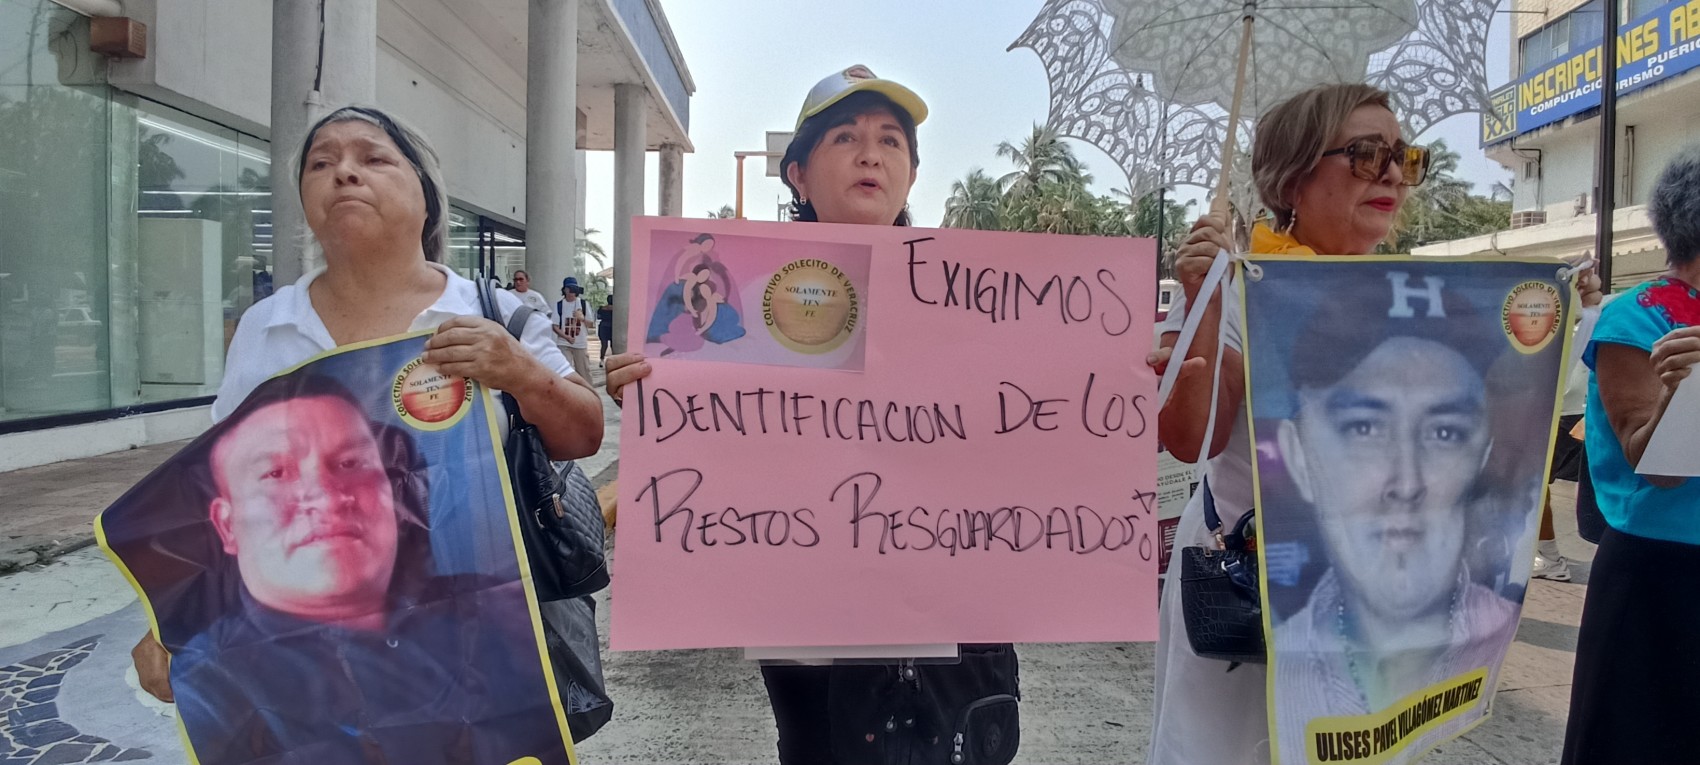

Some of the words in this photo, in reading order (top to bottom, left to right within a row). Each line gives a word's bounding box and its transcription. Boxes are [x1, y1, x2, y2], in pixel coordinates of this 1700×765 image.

[1518, 17, 1659, 112] INSCRIPCINES
[1615, 64, 1664, 92] RISMO
[1530, 78, 1602, 116] COMPUTACIO
[762, 273, 782, 327] COLECTIVO
[782, 258, 829, 275] SOLECITO
[831, 267, 845, 281] DE
[843, 279, 858, 334] VERACRUZ
[785, 285, 839, 298] SOLAMENTE
[802, 298, 820, 308] TEN
[902, 236, 1132, 337] EXIGIMOS
[1385, 270, 1447, 318] H
[1502, 295, 1514, 335] COLECTIVO
[1513, 282, 1545, 297] SOLECITO
[1550, 294, 1561, 335] VERACRUZ
[804, 310, 817, 318] FE
[393, 374, 408, 417] COLECTIVO
[636, 377, 967, 445] IDENTIFICACION
[992, 381, 1070, 437] DE
[1080, 371, 1149, 439] LOS
[634, 467, 822, 553] RESTOS
[1315, 729, 1371, 762] ULISES
[1373, 716, 1399, 755] PAVEL
[1398, 694, 1443, 741] VILLAGÓMEZ
[1442, 677, 1483, 715] MARTINEZ
